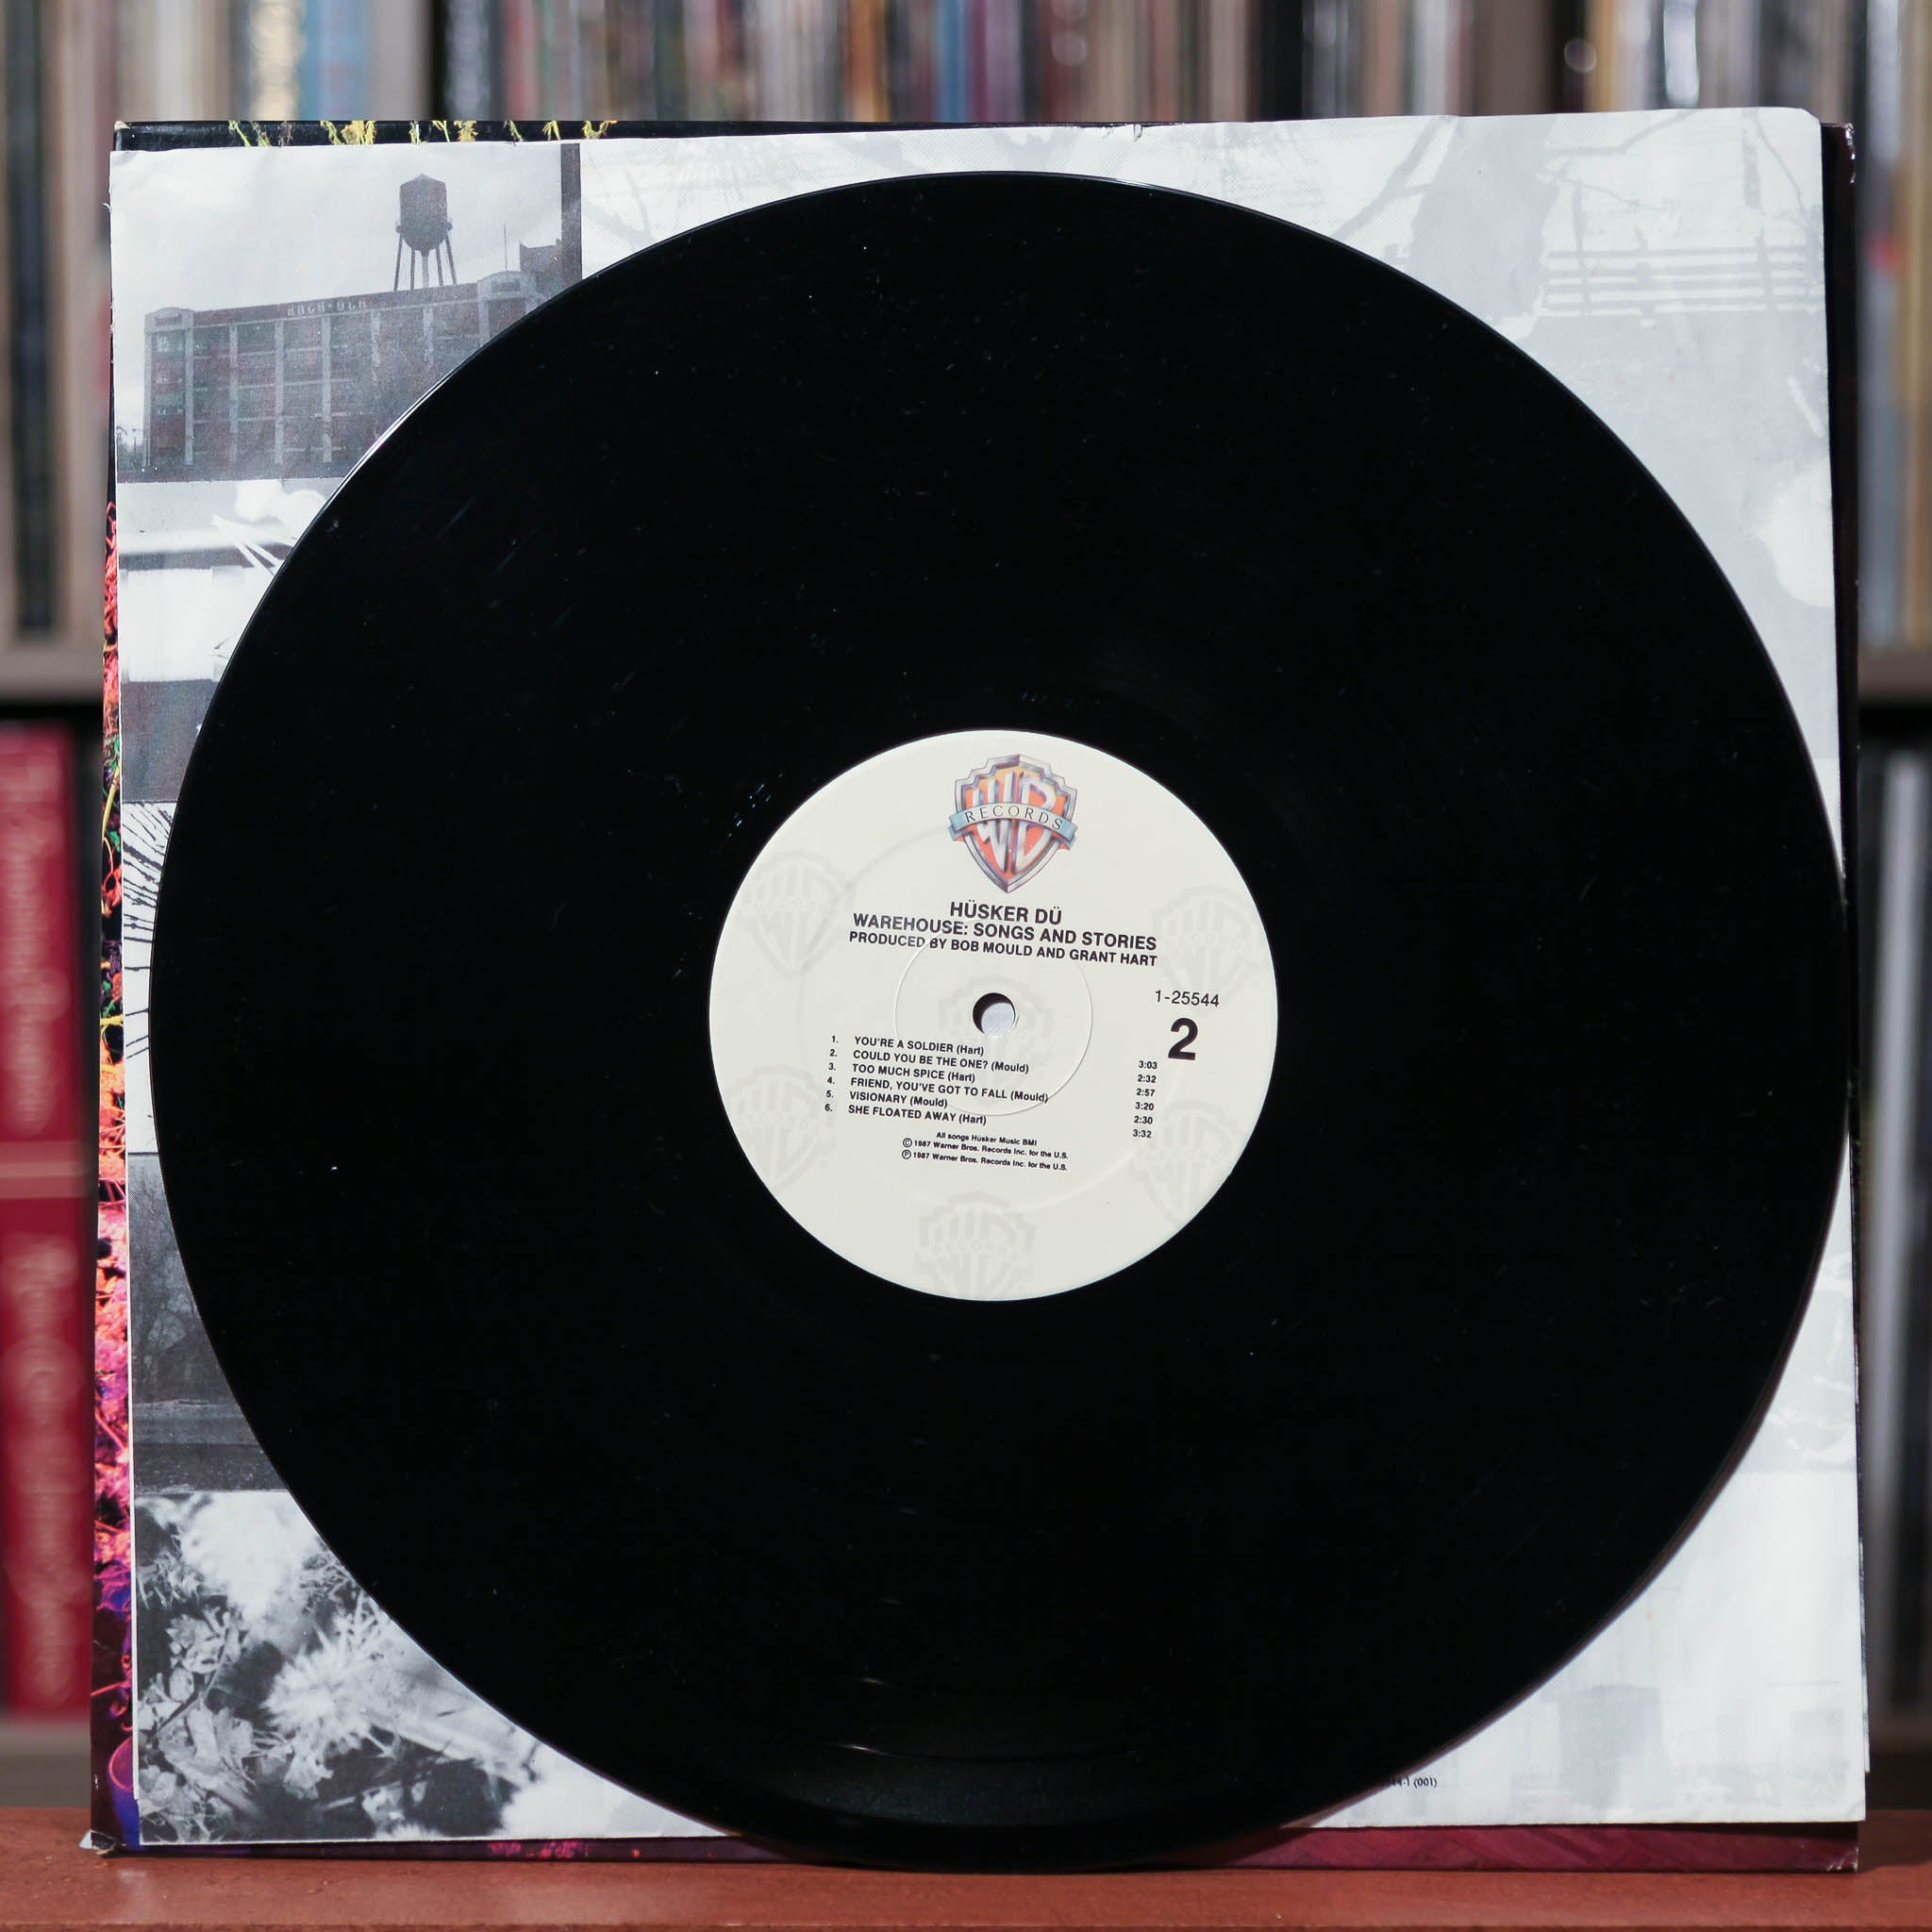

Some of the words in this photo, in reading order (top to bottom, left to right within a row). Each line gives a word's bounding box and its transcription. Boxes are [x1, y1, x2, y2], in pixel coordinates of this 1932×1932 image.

[964, 805, 1063, 830] RECORDS
[950, 899, 1029, 923] HÜSKER
[1034, 906, 1062, 925] DÜ
[853, 912, 969, 936] WAREHOUSE:
[973, 922, 1035, 941] SONGS
[1039, 927, 1077, 944] AND
[1081, 931, 1157, 951] STORIES
[849, 930, 925, 948] PRODUCED
[929, 937, 948, 950] BY
[950, 939, 979, 952] BOB
[982, 941, 1033, 957] MOULD
[1036, 946, 1066, 959] AND
[1069, 948, 1118, 963] GRANT
[1120, 952, 1158, 967] HART
[1155, 989, 1220, 1008] 1-25544
[831, 1035, 839, 1043] 1.
[854, 1036, 895, 1048] YOU'RE
[896, 1040, 905, 1049] A
[907, 1040, 954, 1053] SOLDIER
[956, 1044, 984, 1058] (Hart)
[1167, 1017, 1199, 1061] 2
[829, 1048, 838, 1058] 2.
[853, 1049, 891, 1061] COULD
[893, 1053, 917, 1064] YOU
[919, 1055, 934, 1065] BE
[936, 1056, 958, 1067] THE
[959, 1058, 989, 1070] ONE?
[991, 1060, 1029, 1075] (Mould)
[1138, 1059, 1158, 1070] 3:03
[828, 1062, 837, 1071] 3.
[852, 1063, 875, 1074] TOO
[877, 1065, 910, 1077] MUCH
[912, 1068, 945, 1080] SPICE
[947, 1071, 975, 1085] (Hart)
[1137, 1074, 1157, 1084] 2:32
[826, 1075, 835, 1085] 4.
[850, 1076, 892, 1091] FRIEND,
[895, 1080, 936, 1093] YOU'VE
[938, 1084, 961, 1095] GOT
[963, 1086, 979, 1097] TO
[981, 1088, 1008, 1099] FALL
[1010, 1090, 1050, 1104] (Mould)
[1136, 1087, 1156, 1097] 2:57
[825, 1090, 834, 1099] 5.
[849, 1091, 908, 1105] VISIONARY
[909, 1095, 948, 1109] (Mould)
[1135, 1101, 1155, 1111] 3:20
[824, 1103, 833, 1112] 6.
[848, 1104, 871, 1115] SHE
[872, 1106, 923, 1120] FLOATED
[924, 1110, 957, 1122] AWAY
[958, 1113, 987, 1126] (Hart)
[1133, 1115, 1154, 1125] 2:30
[947, 1133, 970, 1142] songs
[998, 1136, 1021, 1145] Music
[1022, 1139, 1038, 1147] BMI
[1132, 1128, 1152, 1139] 3:32
[933, 1141, 959, 1150] Warner
[960, 1142, 980, 1152] Bros.
[981, 1144, 1012, 1155] Records
[1013, 1147, 1027, 1156] Inc.
[1040, 1150, 1052, 1158] the
[1054, 1151, 1069, 1159] U.S.
[931, 1153, 958, 1162] Warner
[959, 1155, 978, 1163] Bros.
[980, 1157, 1011, 1166] Records
[1012, 1159, 1027, 1168] Inc.
[1027, 1160, 1039, 1169] for
[1039, 1161, 1051, 1170] the
[1052, 1162, 1068, 1171] U.S.
[1413, 1777, 1438, 1789] (001)
